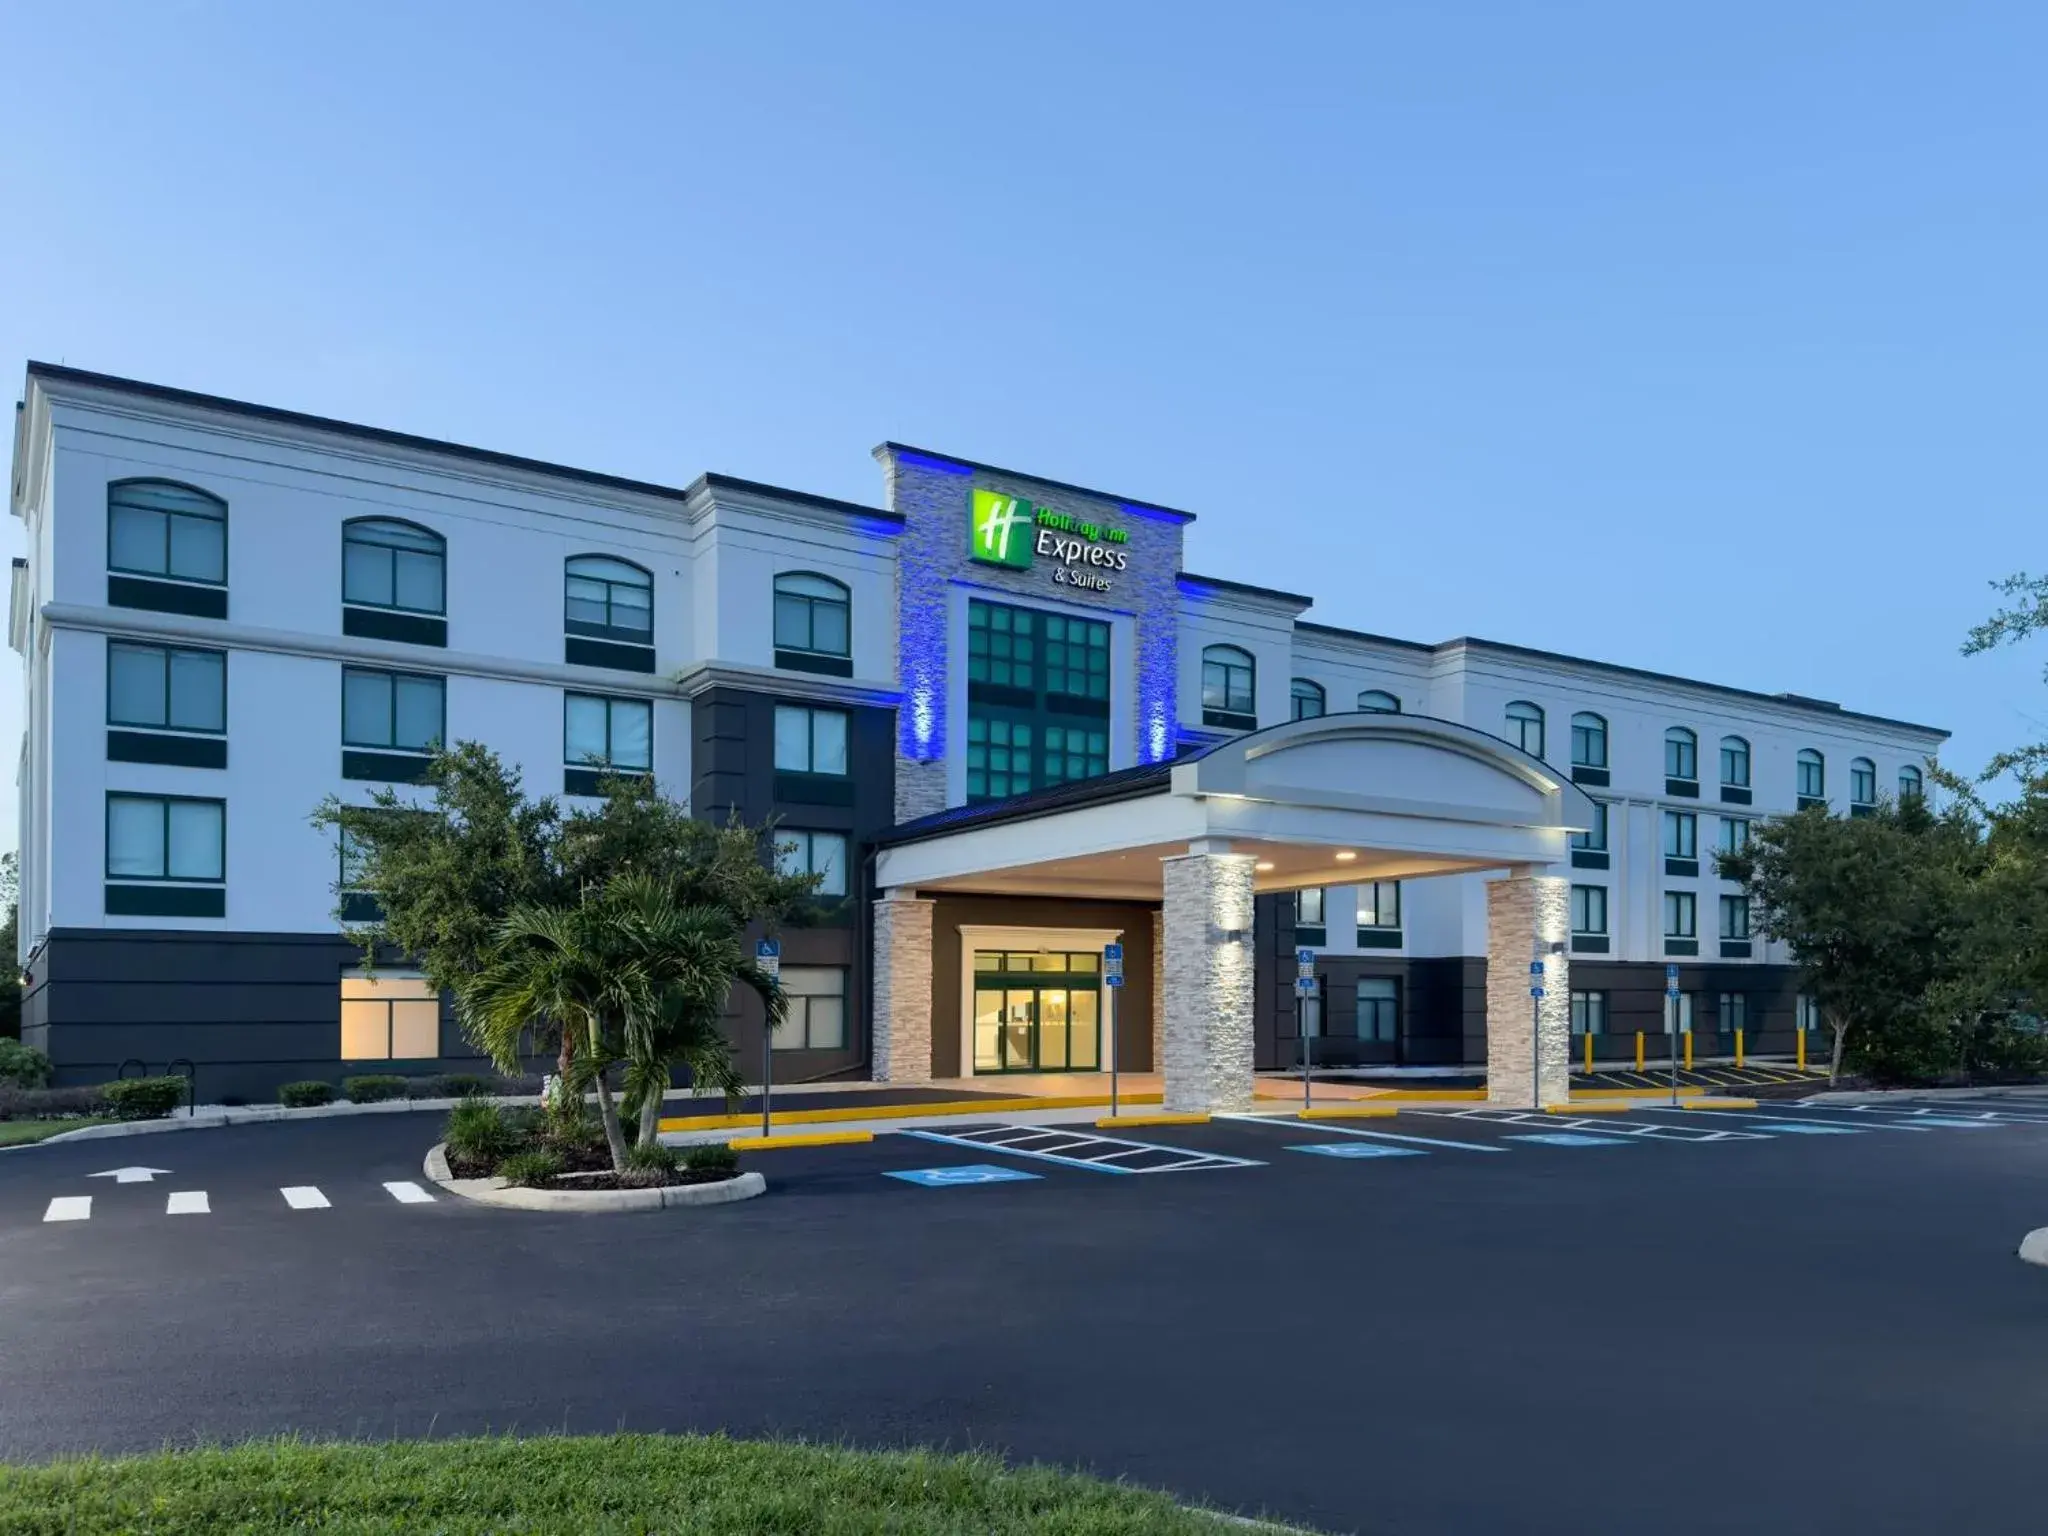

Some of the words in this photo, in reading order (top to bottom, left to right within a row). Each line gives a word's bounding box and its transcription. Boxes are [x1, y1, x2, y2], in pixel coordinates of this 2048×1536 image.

[1037, 529, 1128, 570] Express
[1055, 567, 1065, 582] &
[1070, 570, 1111, 591] Suites
